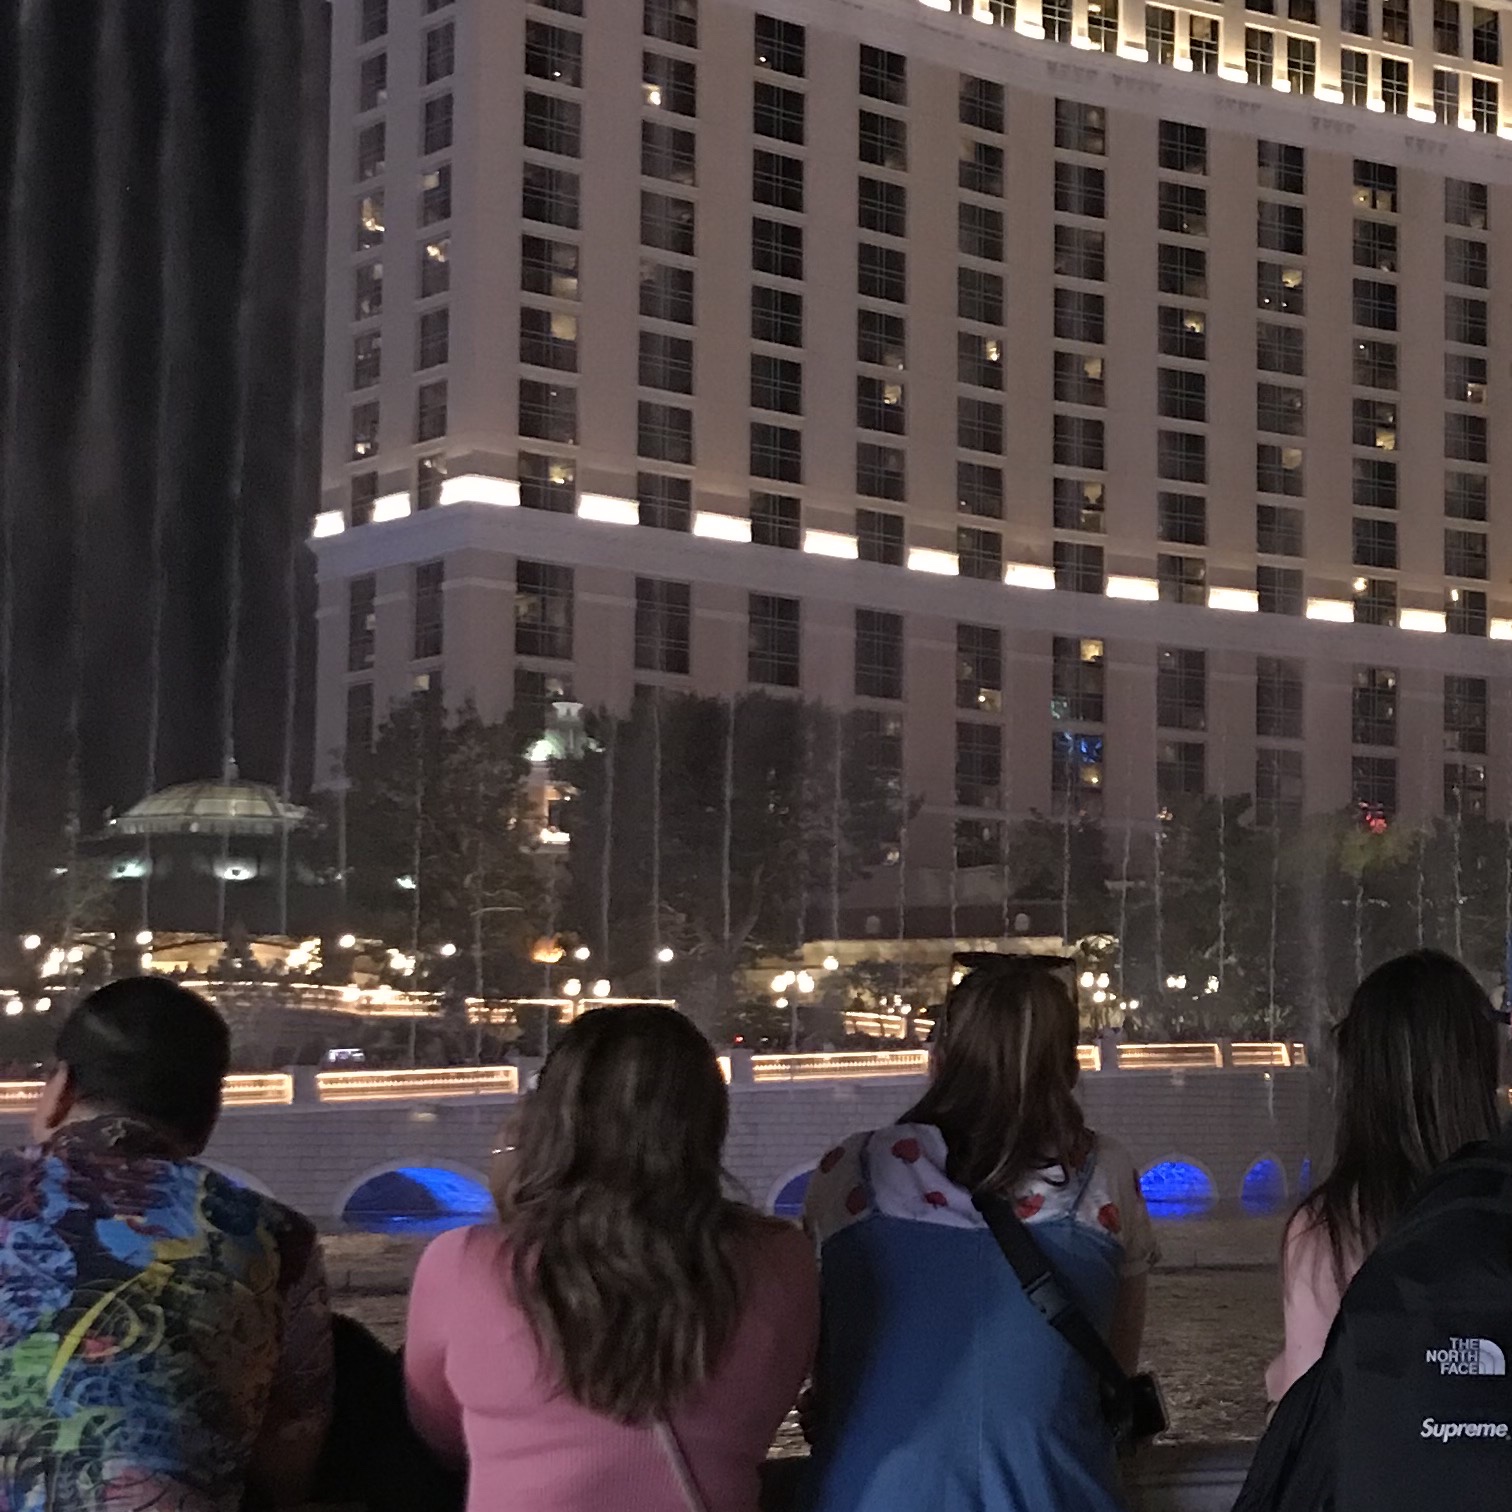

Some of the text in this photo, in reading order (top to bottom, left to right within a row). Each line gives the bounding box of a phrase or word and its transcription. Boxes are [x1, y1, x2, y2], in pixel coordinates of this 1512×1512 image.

[1449, 1337, 1479, 1350] THE
[1426, 1350, 1478, 1363] NORTH
[1440, 1362, 1479, 1375] FACE
[1420, 1418, 1509, 1443] Supreme
